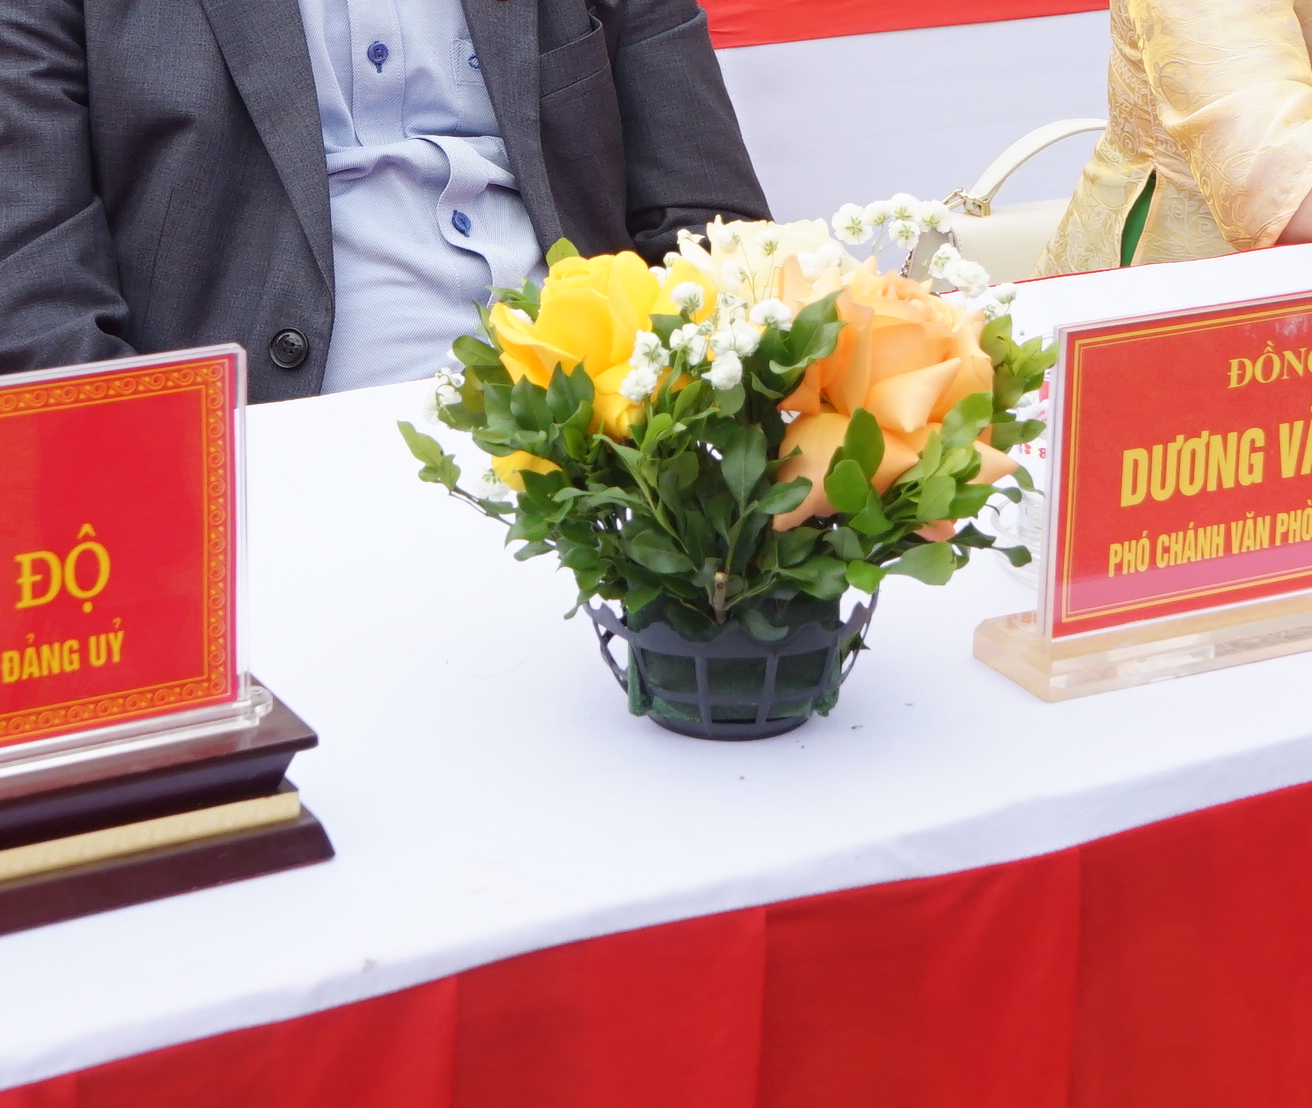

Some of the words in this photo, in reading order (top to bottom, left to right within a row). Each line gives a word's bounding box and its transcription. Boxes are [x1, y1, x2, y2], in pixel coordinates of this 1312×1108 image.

[1120, 427, 1266, 507] DƯƠNG
[14, 523, 111, 613] ĐỘ
[1108, 530, 1150, 577] PHÓ
[1156, 522, 1225, 569] CHÁNH
[1230, 512, 1270, 555] VĂN
[1, 632, 80, 684] ĐẢNG
[89, 617, 125, 667] UỶ
